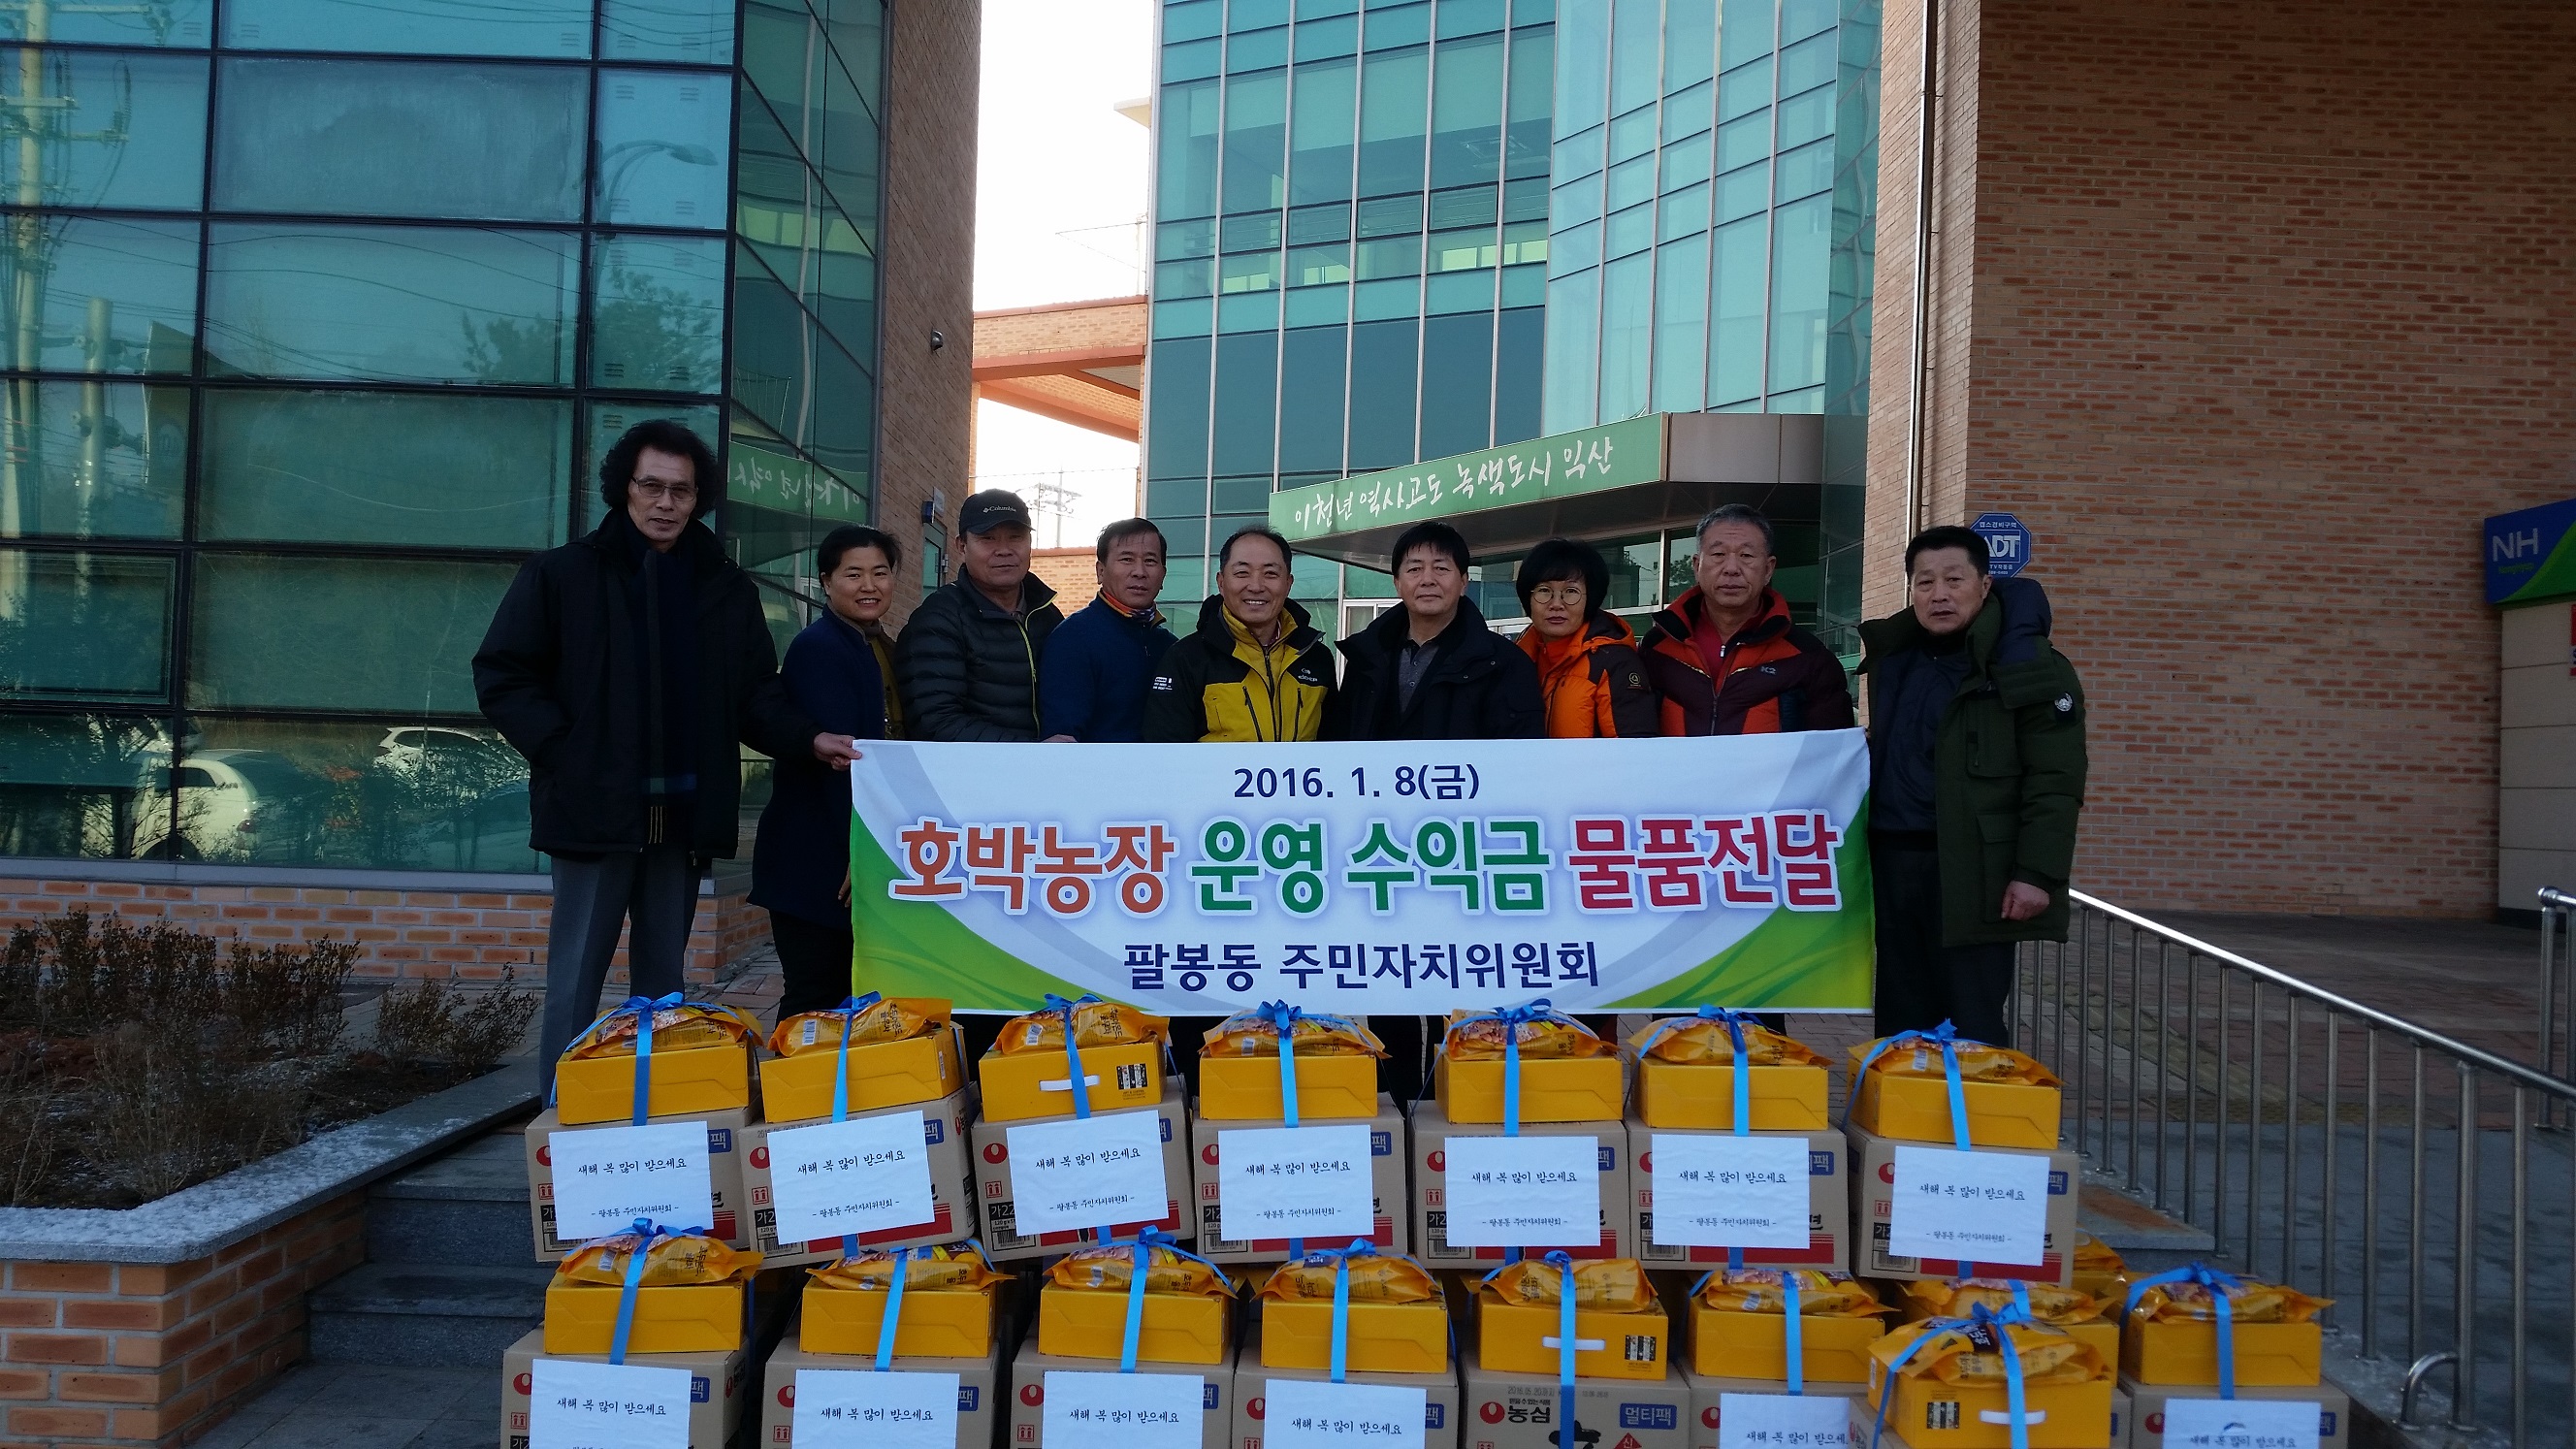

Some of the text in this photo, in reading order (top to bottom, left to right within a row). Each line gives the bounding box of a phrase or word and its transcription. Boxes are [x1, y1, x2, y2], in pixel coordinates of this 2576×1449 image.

[1295, 436, 1614, 531] 이천년 역사고도 녹색도시 익산
[2492, 528, 2539, 563] NH
[1233, 762, 1480, 801] 2016. 1. 8(금)
[892, 812, 1840, 916] 호박농장 운영 수익금 물품전달
[1123, 940, 1599, 993] 팔봉동 주민자치위원회
[578, 1158, 688, 1175] 새해 복 많이 받으세요
[797, 1150, 906, 1175] 새해 복 많이 받으세요
[1035, 1148, 1142, 1170] 새해 복 많이 받으세요
[1245, 1161, 1351, 1175] 새해 복 많이 받으세요
[1472, 1172, 1578, 1183] 새해 복 많이 받으세요
[1679, 1171, 1787, 1183] 새해 복 많이 받으세요
[1920, 1183, 2026, 1200] 새해 복 많이 받으세요
[844, 1199, 893, 1212] 주민자치위원회
[1080, 1195, 1128, 1208] 주민자치위원회
[623, 1205, 672, 1215] 주민자치위원회
[1287, 1208, 1335, 1217] 주민자치위원회
[1721, 1218, 1770, 1227] 주민자치위원회
[1957, 1233, 2006, 1242] 주민자치위원회
[557, 1398, 666, 1415] 새해 복 많이 받으세요
[821, 1407, 934, 1421] 새해 복 많이 받으세요
[1507, 1405, 1551, 1424] 농심
[1069, 1409, 1179, 1424] 새해 복 많이 받으세요
[1625, 1405, 1672, 1427] 멀티팩
[1291, 1418, 1402, 1434] 새해 복 많이 받으세요
[1747, 1432, 1767, 1442] 새해
[1771, 1433, 1784, 1443] 복
[1788, 1433, 1809, 1444] 많이
[1814, 1431, 1852, 1445] 받으세
